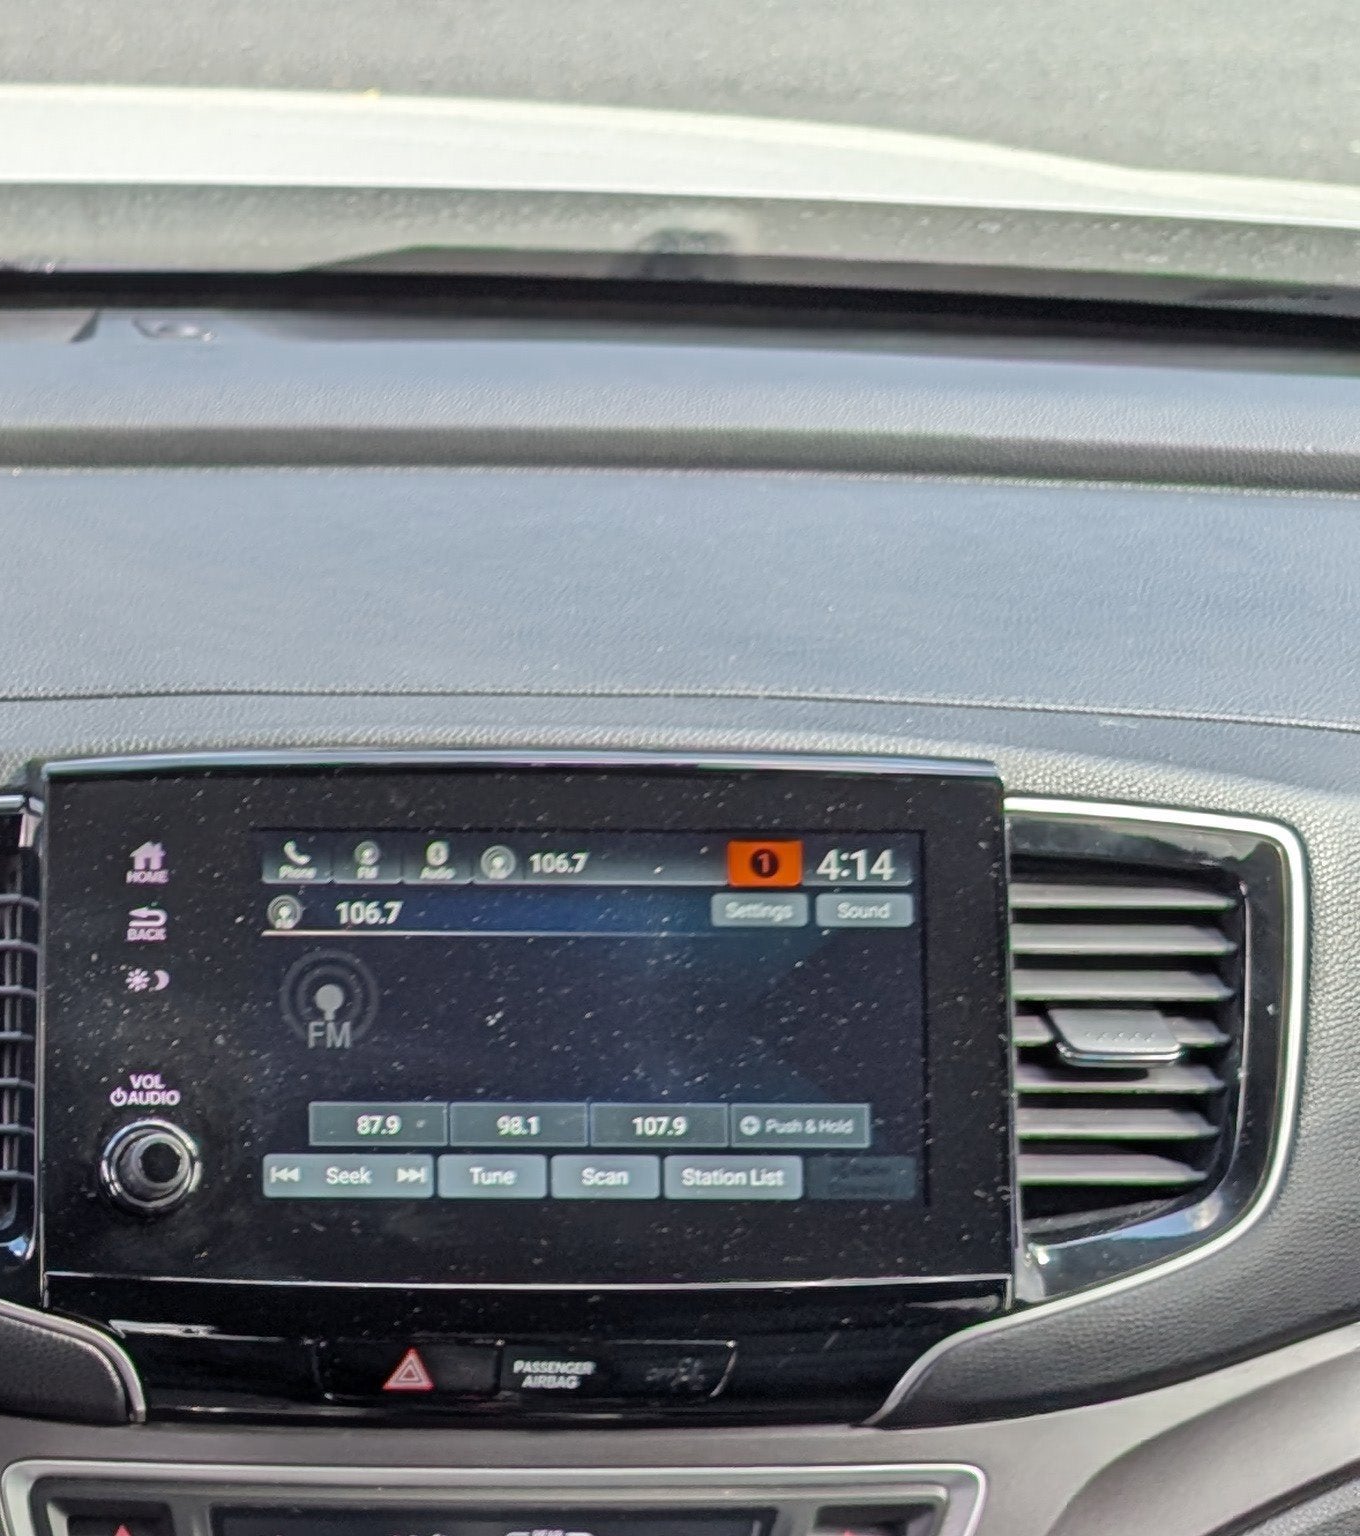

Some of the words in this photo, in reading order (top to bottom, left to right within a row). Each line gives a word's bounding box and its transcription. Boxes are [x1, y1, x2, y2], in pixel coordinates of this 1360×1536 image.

[530, 852, 590, 874] 106.7
[816, 849, 896, 881] 4:14
[126, 870, 169, 884] HOME
[336, 901, 403, 925] 106.7
[725, 902, 793, 923] Settings
[837, 902, 890, 920] Sound
[127, 928, 167, 941] BACK
[308, 1021, 351, 1049] FM
[130, 1074, 165, 1089] VOL
[127, 1090, 180, 1106] AUDIO
[356, 1115, 402, 1135] 87.9
[497, 1115, 540, 1135] 98.1
[632, 1115, 688, 1136] 107.9
[765, 1118, 803, 1134] Push
[805, 1118, 817, 1134] &
[818, 1118, 854, 1134] Hold
[326, 1166, 372, 1186] Seek
[469, 1166, 518, 1186] Tune
[581, 1167, 629, 1187] Scan
[681, 1166, 747, 1187] Station
[750, 1167, 784, 1187] List
[513, 1360, 596, 1375] PASSENGER
[521, 1375, 580, 1389] AIRBAG
